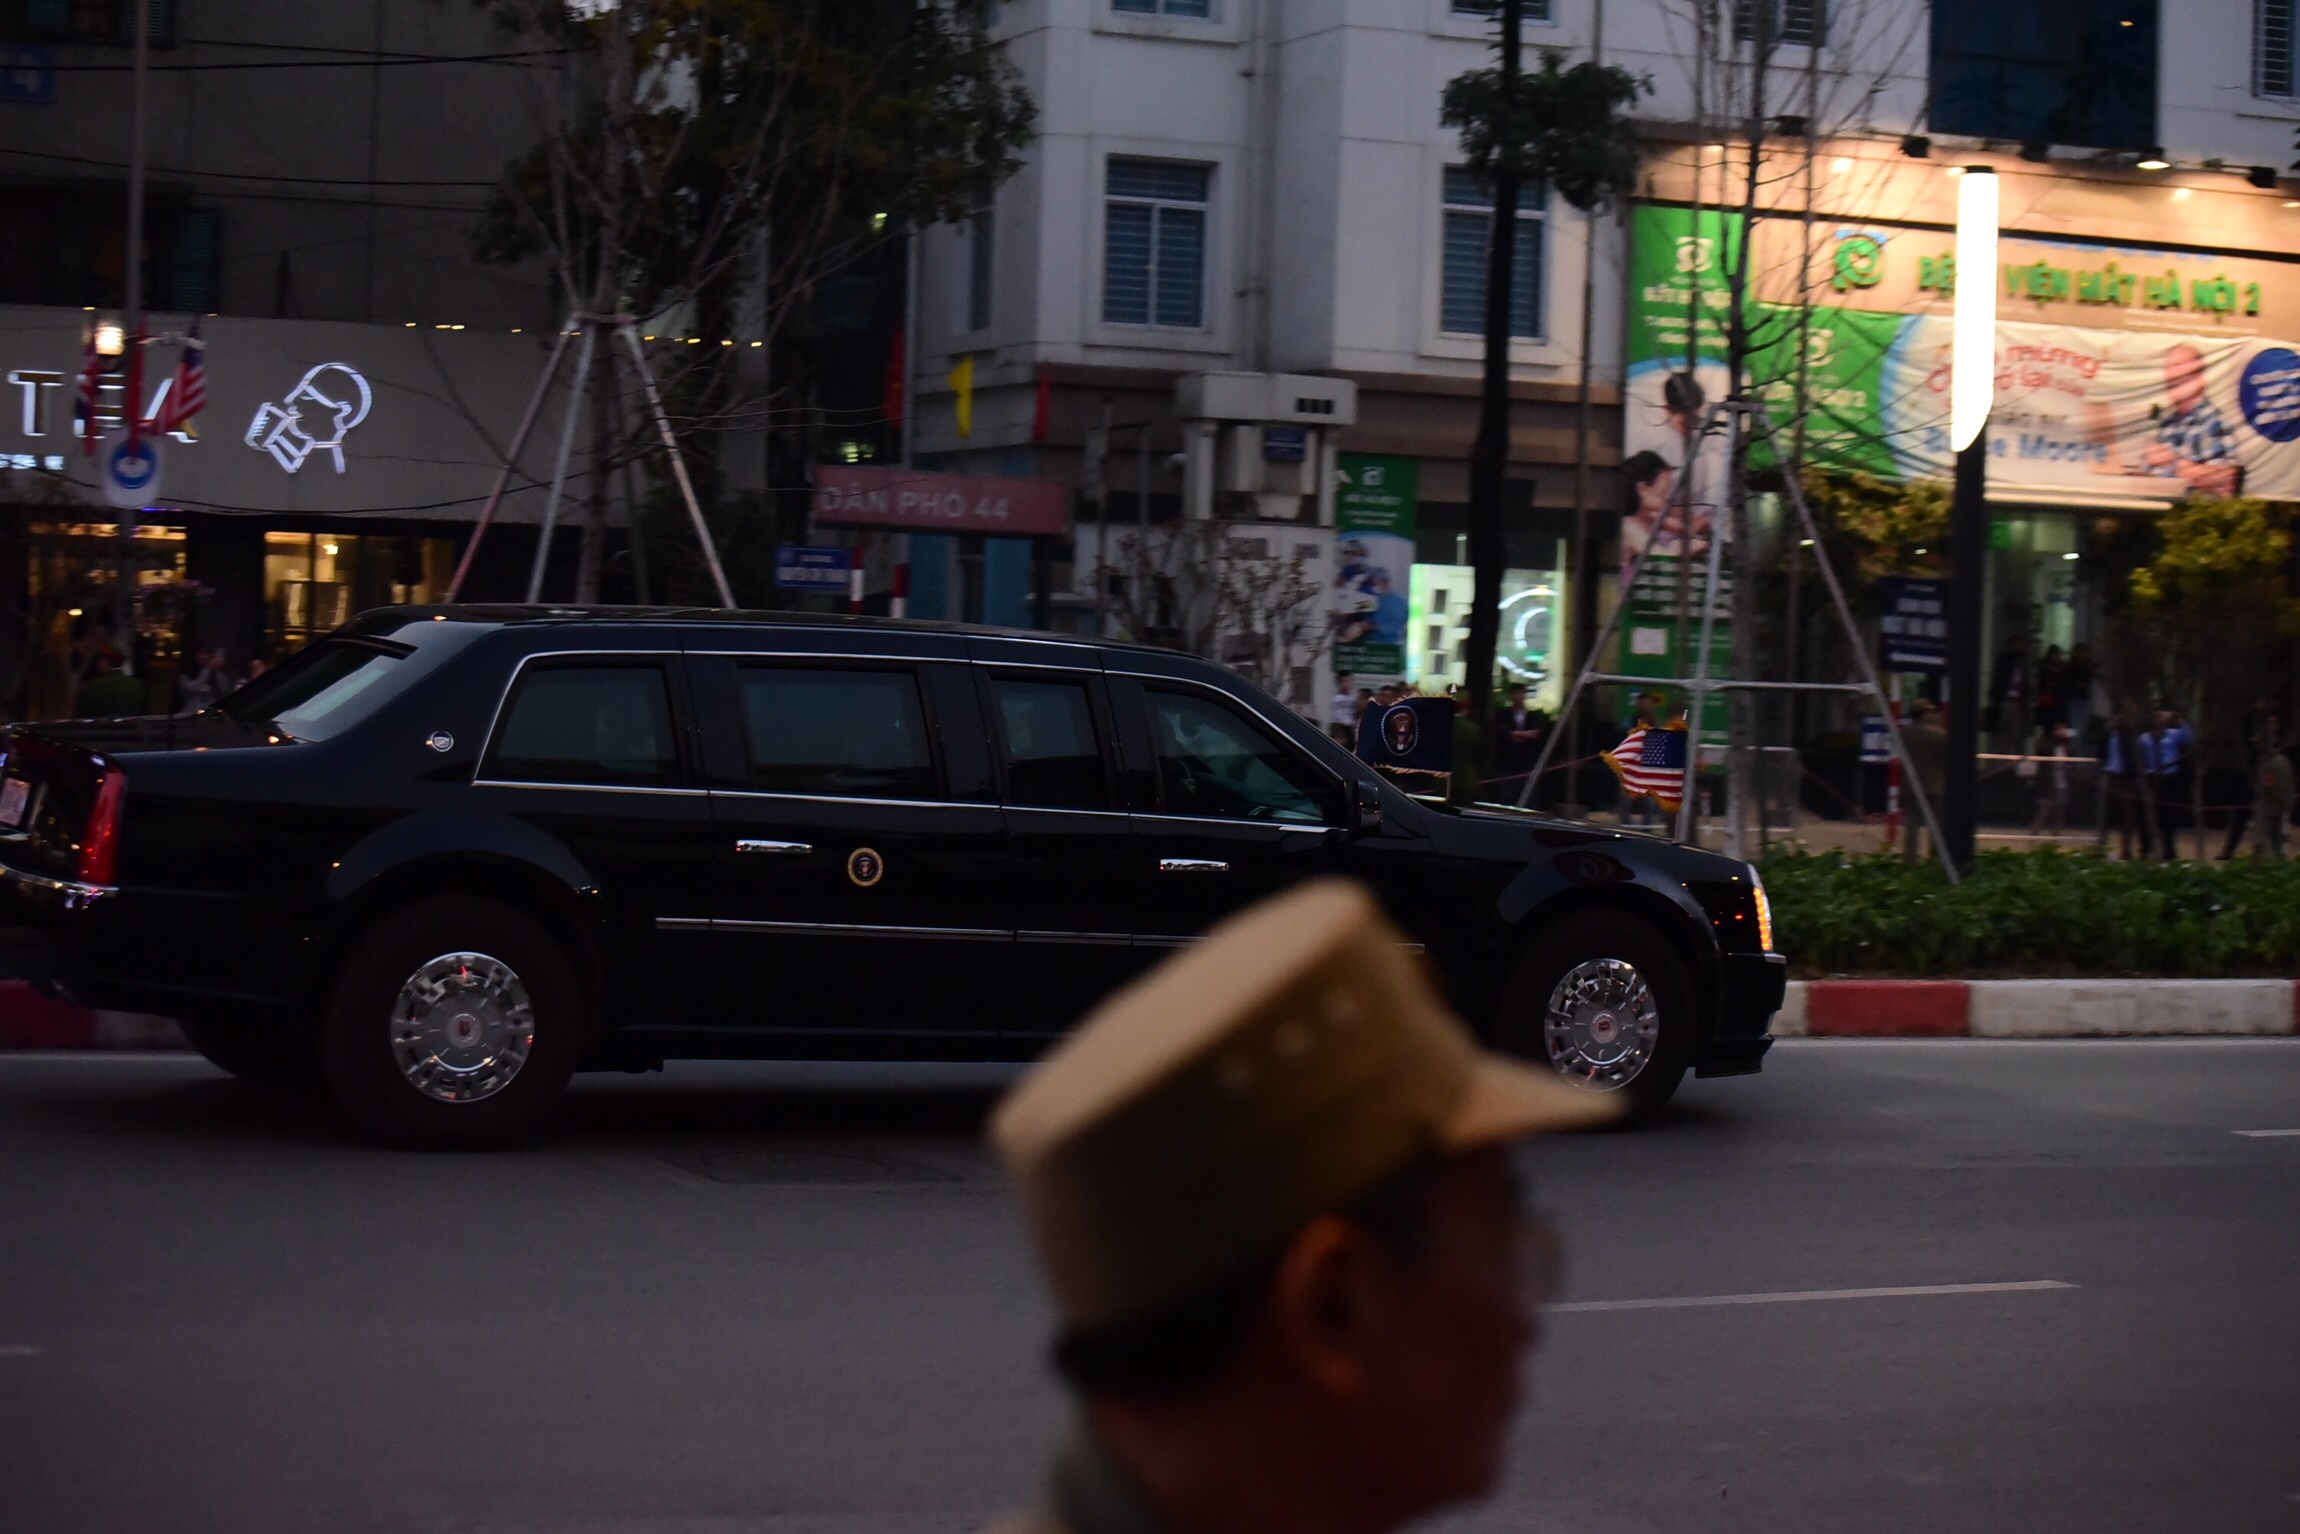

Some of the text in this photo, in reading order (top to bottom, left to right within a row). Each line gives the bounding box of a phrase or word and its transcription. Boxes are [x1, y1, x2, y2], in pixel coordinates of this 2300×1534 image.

[2003, 259, 2070, 306] VIỆN
[2144, 268, 2181, 309] HÀ
[2191, 273, 2238, 324] NỘI
[2245, 282, 2259, 316] 2
[974, 497, 1009, 521] 44
